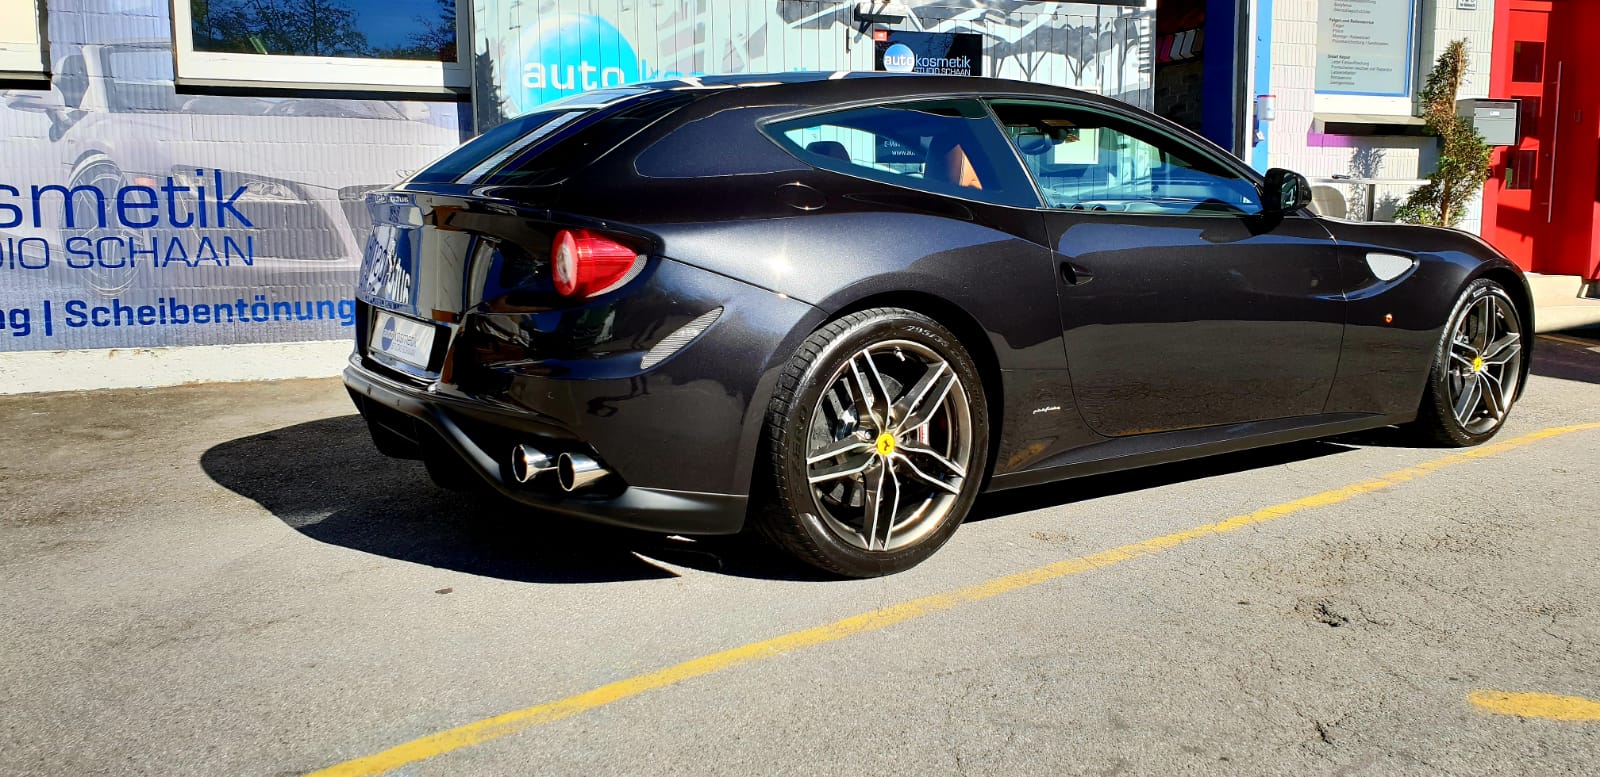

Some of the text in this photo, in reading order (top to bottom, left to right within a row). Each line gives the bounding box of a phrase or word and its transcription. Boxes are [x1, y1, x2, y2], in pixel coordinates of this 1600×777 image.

[522, 60, 625, 91] auto
[0, 169, 254, 229] smetik
[0, 235, 254, 270] IO SCHAAN
[65, 295, 356, 328] Scheibentönung
